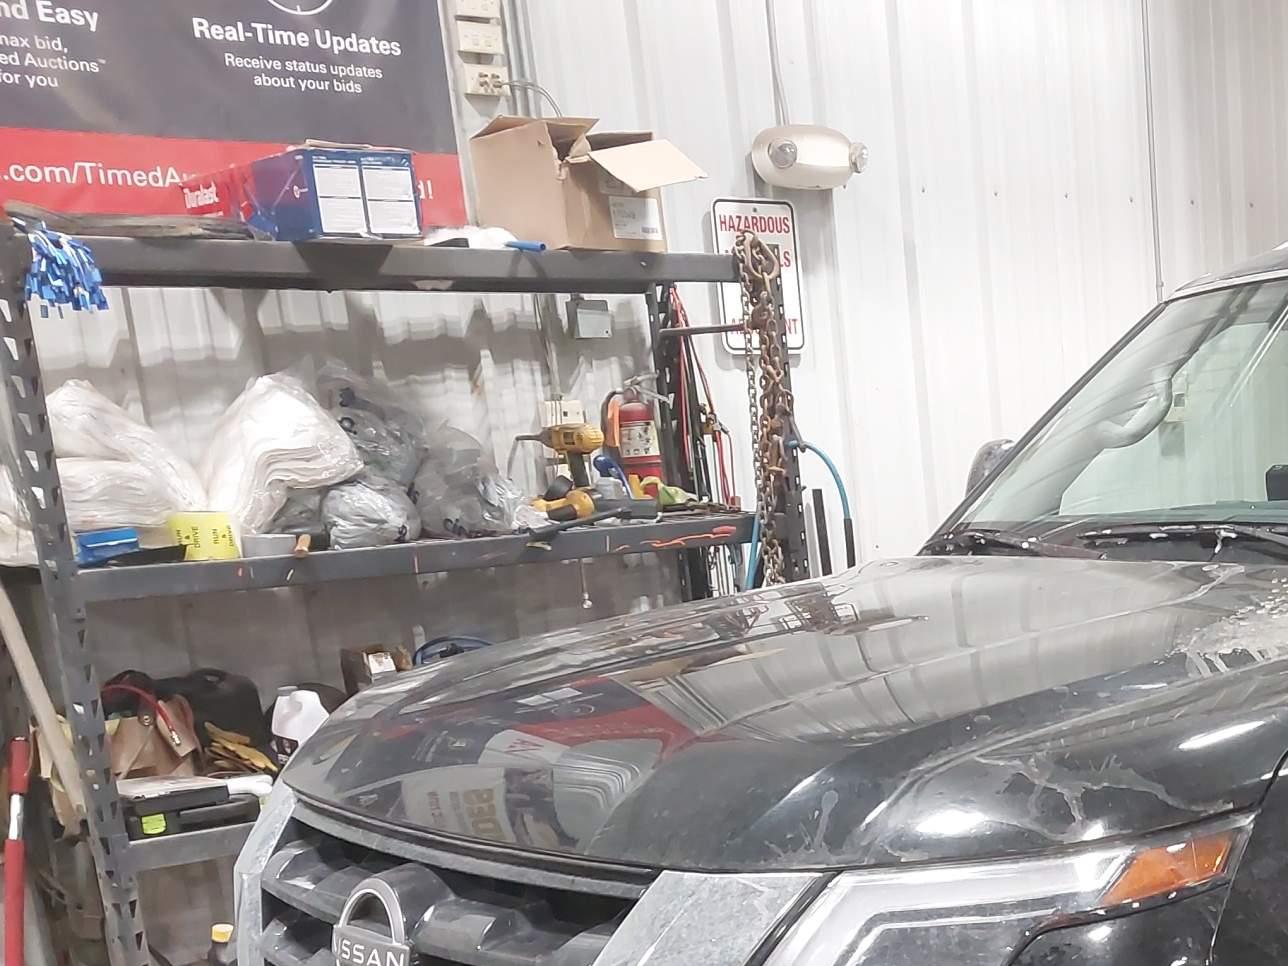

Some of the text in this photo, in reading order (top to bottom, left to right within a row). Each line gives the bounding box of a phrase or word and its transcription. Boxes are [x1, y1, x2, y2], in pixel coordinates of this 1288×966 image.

[36, 0, 98, 32] Easy
[34, 35, 68, 54] bid,
[192, 17, 402, 56] Real-Time Updates
[224, 53, 383, 79] Receive status updates
[25, 74, 59, 88] you
[254, 74, 362, 94] about your bids
[719, 213, 791, 235] HAZARDOUS
